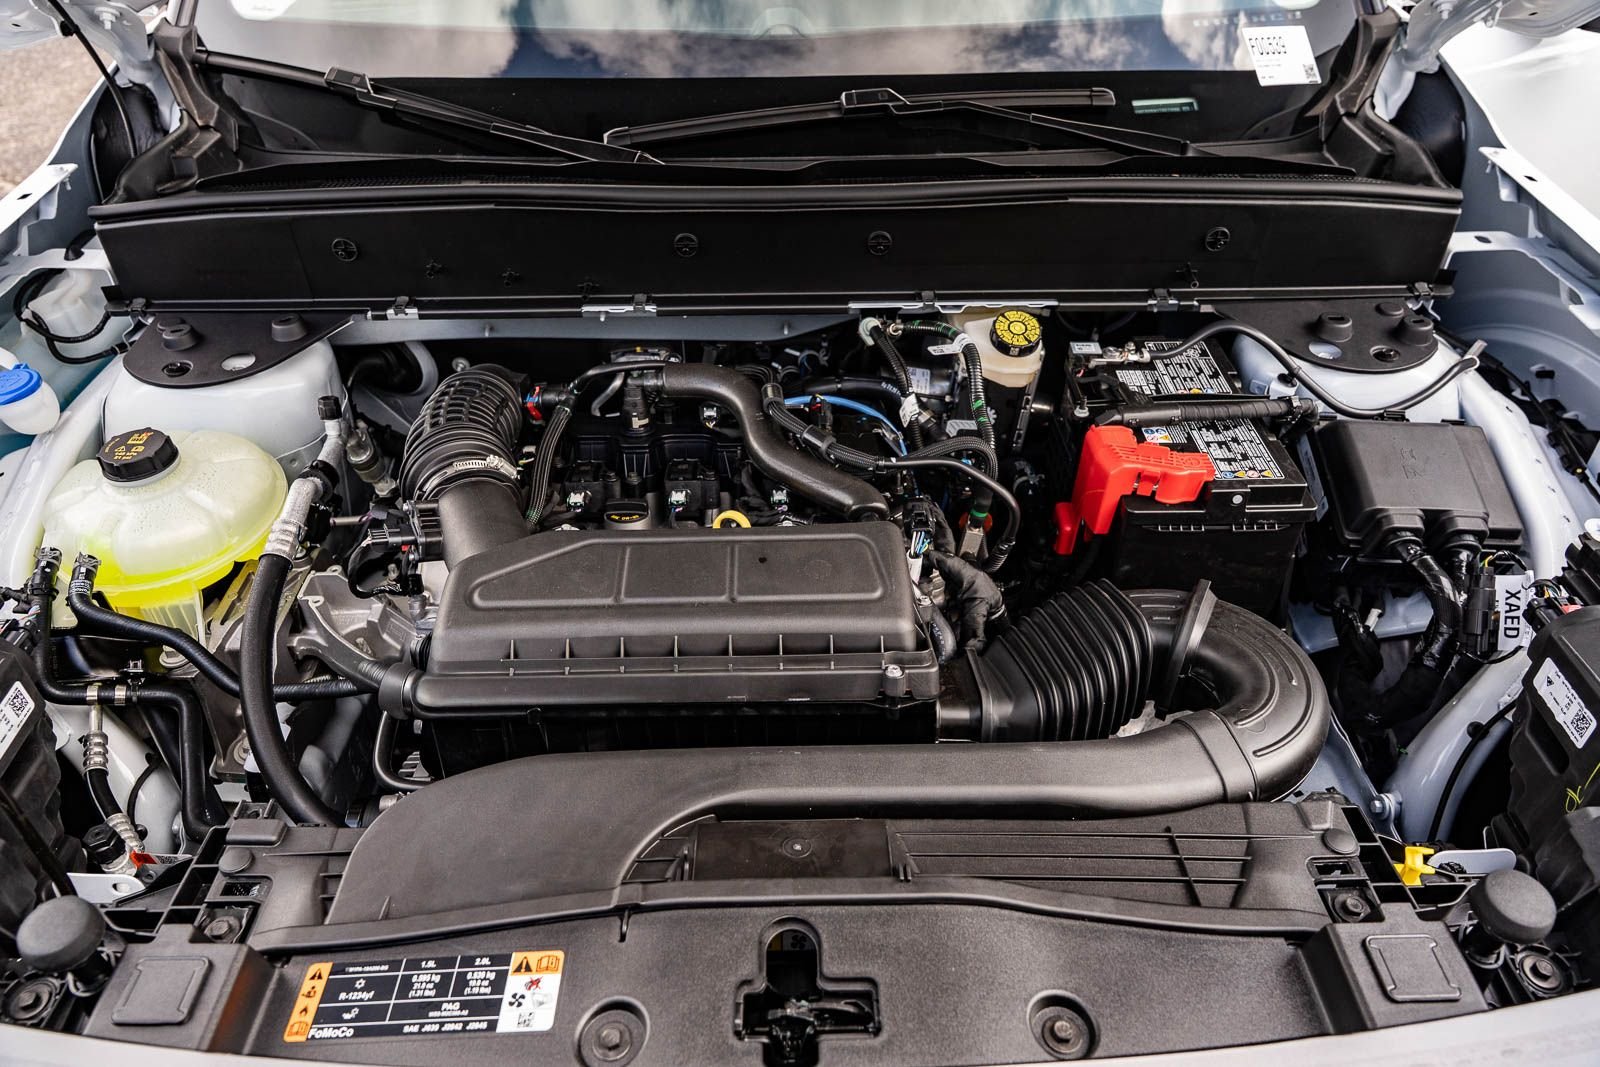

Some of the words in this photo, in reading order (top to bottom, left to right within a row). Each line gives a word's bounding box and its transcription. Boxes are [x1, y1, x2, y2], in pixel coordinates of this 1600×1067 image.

[1504, 589, 1522, 639] XAED
[338, 990, 375, 1001] R-1234yf
[441, 1001, 461, 1011] PAG
[307, 1026, 354, 1039] FoMoCo
[402, 1024, 420, 1033] SAE
